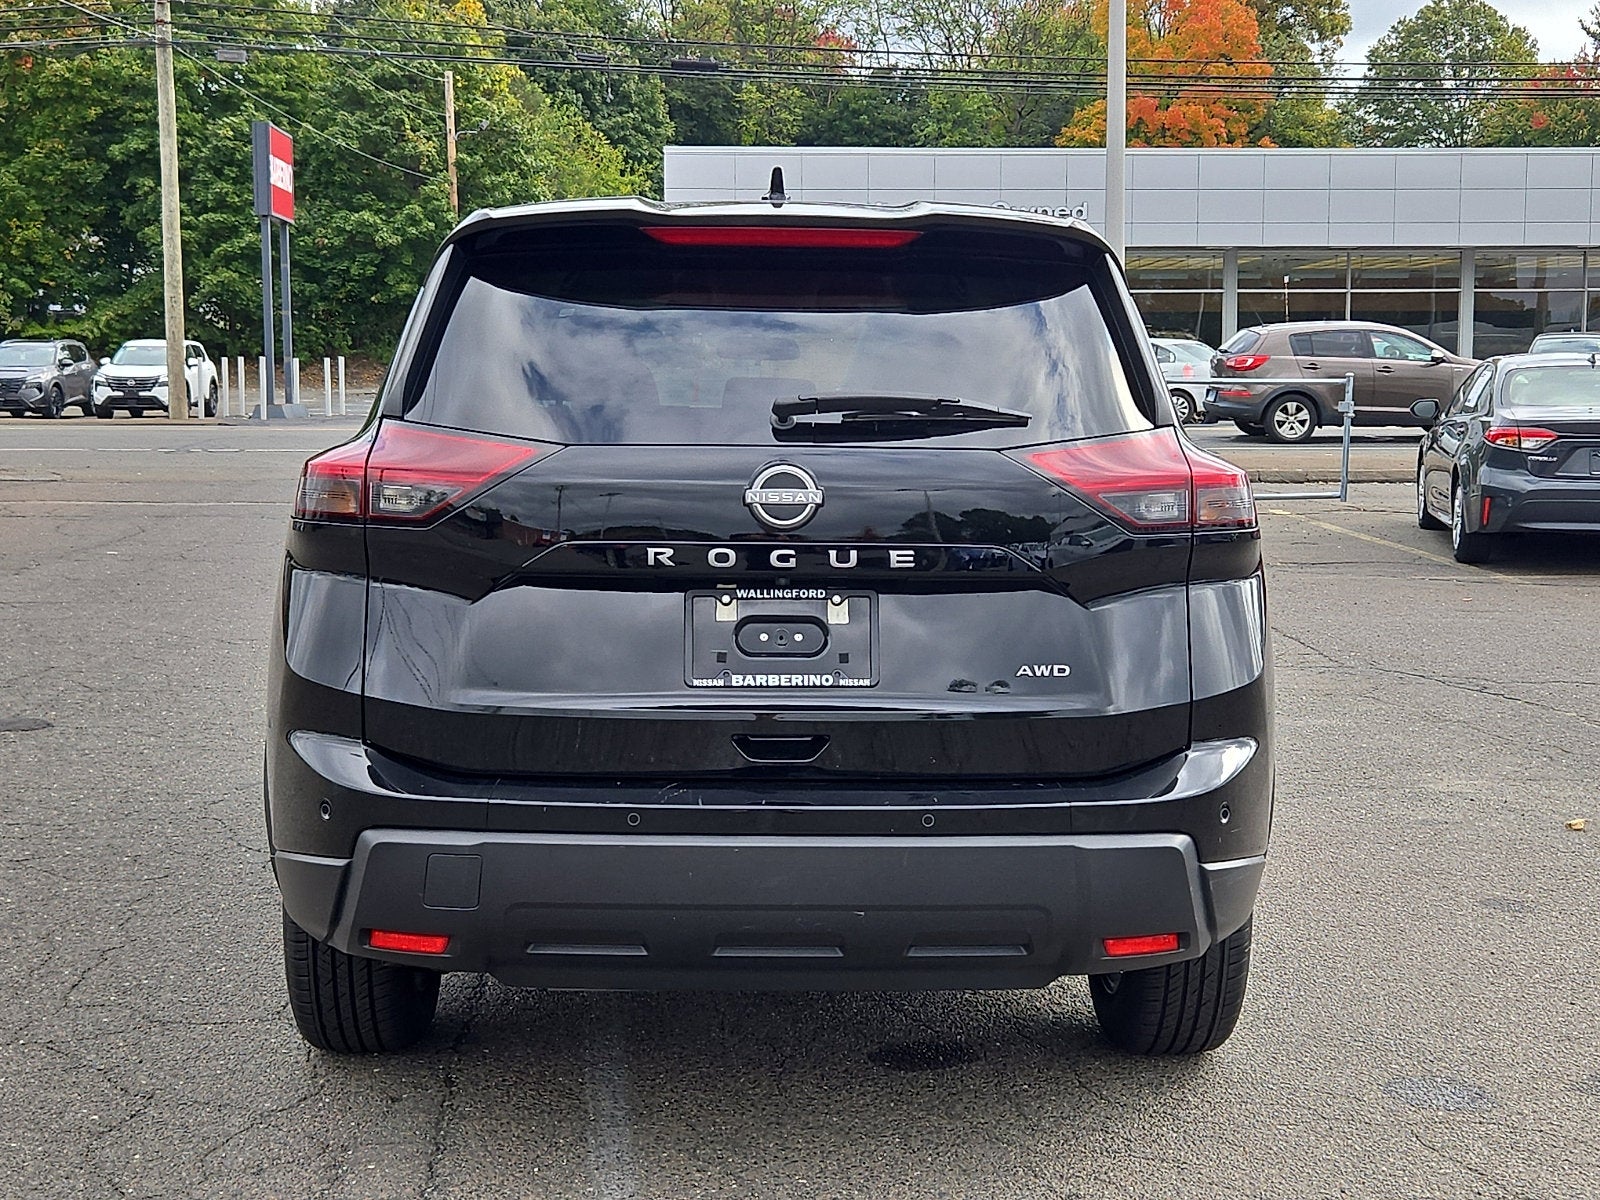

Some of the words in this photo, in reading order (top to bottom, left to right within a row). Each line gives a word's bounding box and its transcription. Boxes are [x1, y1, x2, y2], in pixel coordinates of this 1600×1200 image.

[748, 492, 821, 502] NISSAN
[646, 547, 916, 569] ROGUE
[736, 589, 826, 599] WALLINGFORD
[1015, 664, 1071, 677] AWD
[692, 678, 725, 687] NISSAN
[731, 674, 834, 687] BARBERINO
[839, 678, 871, 687] NISSAN
